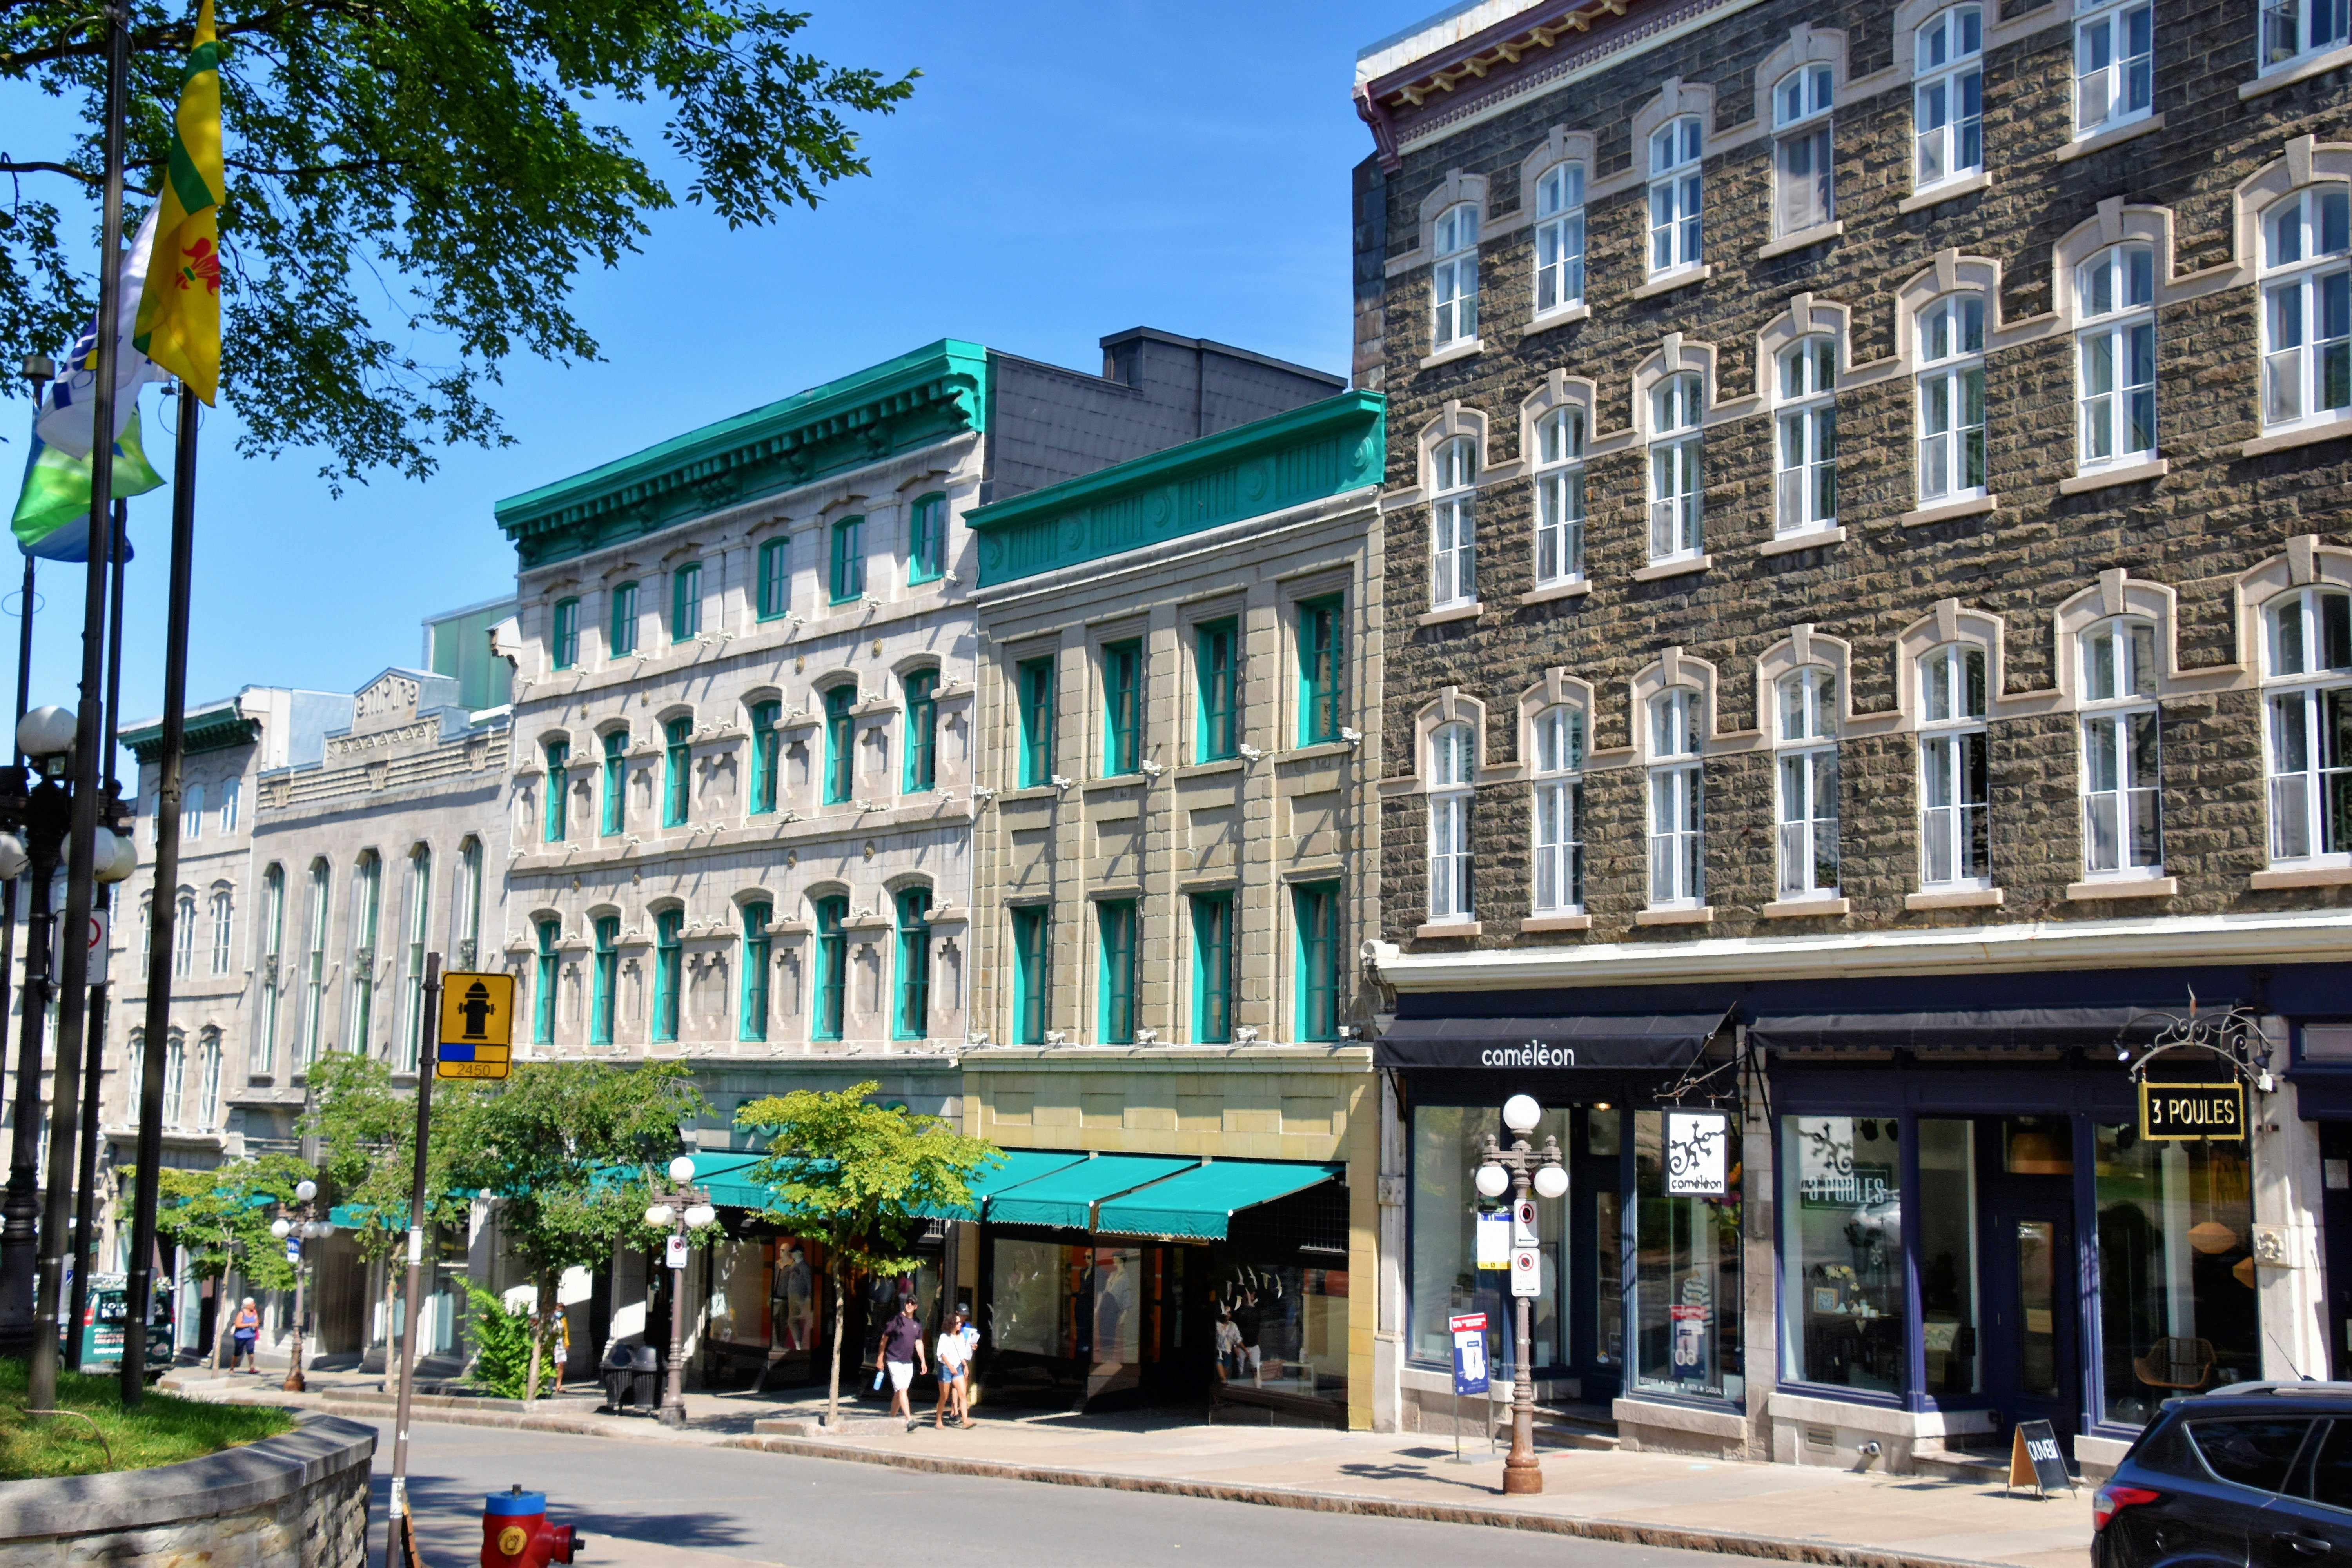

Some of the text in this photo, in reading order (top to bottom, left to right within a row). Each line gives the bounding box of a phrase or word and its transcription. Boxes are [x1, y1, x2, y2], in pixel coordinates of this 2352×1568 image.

[457, 1063, 490, 1076] 2450
[2152, 1098, 2235, 1124] 3 POULES
[1825, 1177, 1884, 1203] POULES
[2027, 1439, 2058, 1461] OUVERT
